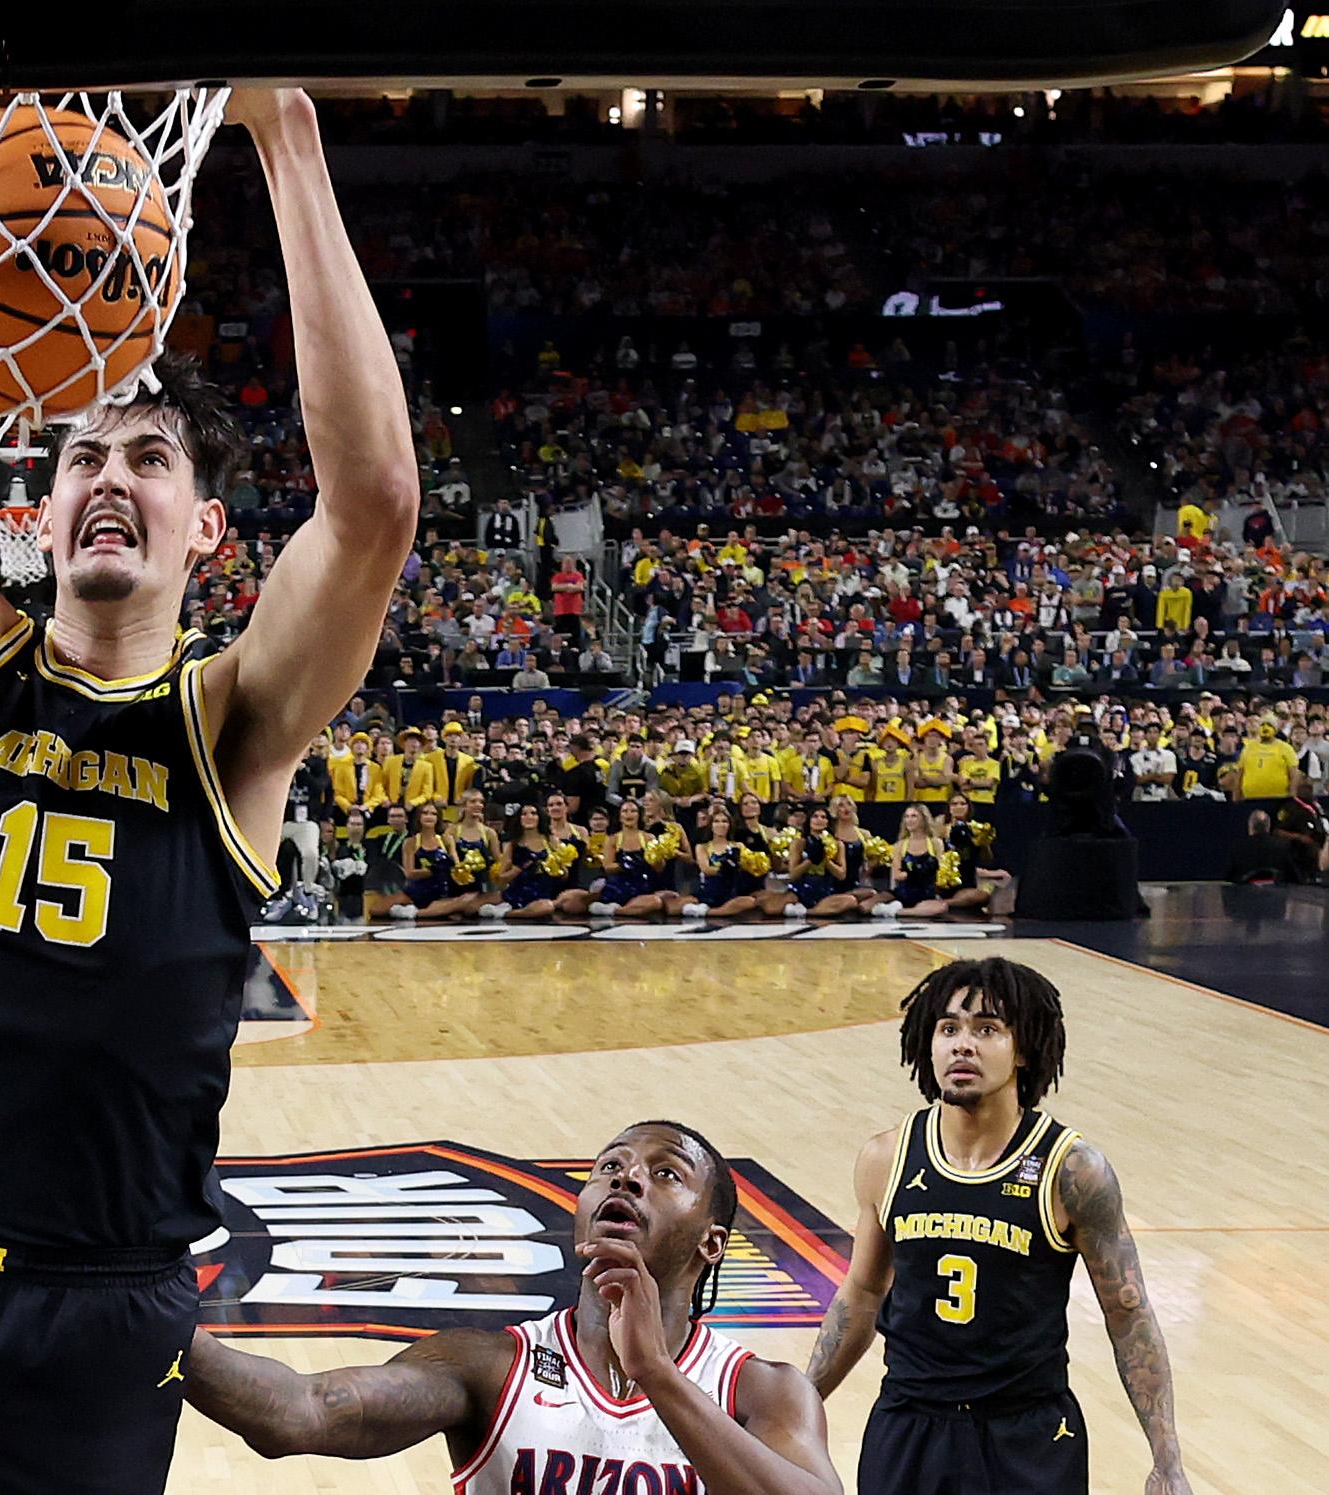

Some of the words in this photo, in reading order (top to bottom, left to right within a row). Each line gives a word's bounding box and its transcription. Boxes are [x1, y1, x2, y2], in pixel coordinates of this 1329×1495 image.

[219, 1169, 565, 1311] FOUR
[894, 1212, 1033, 1256] MICHIGAN
[935, 1253, 977, 1325] 3
